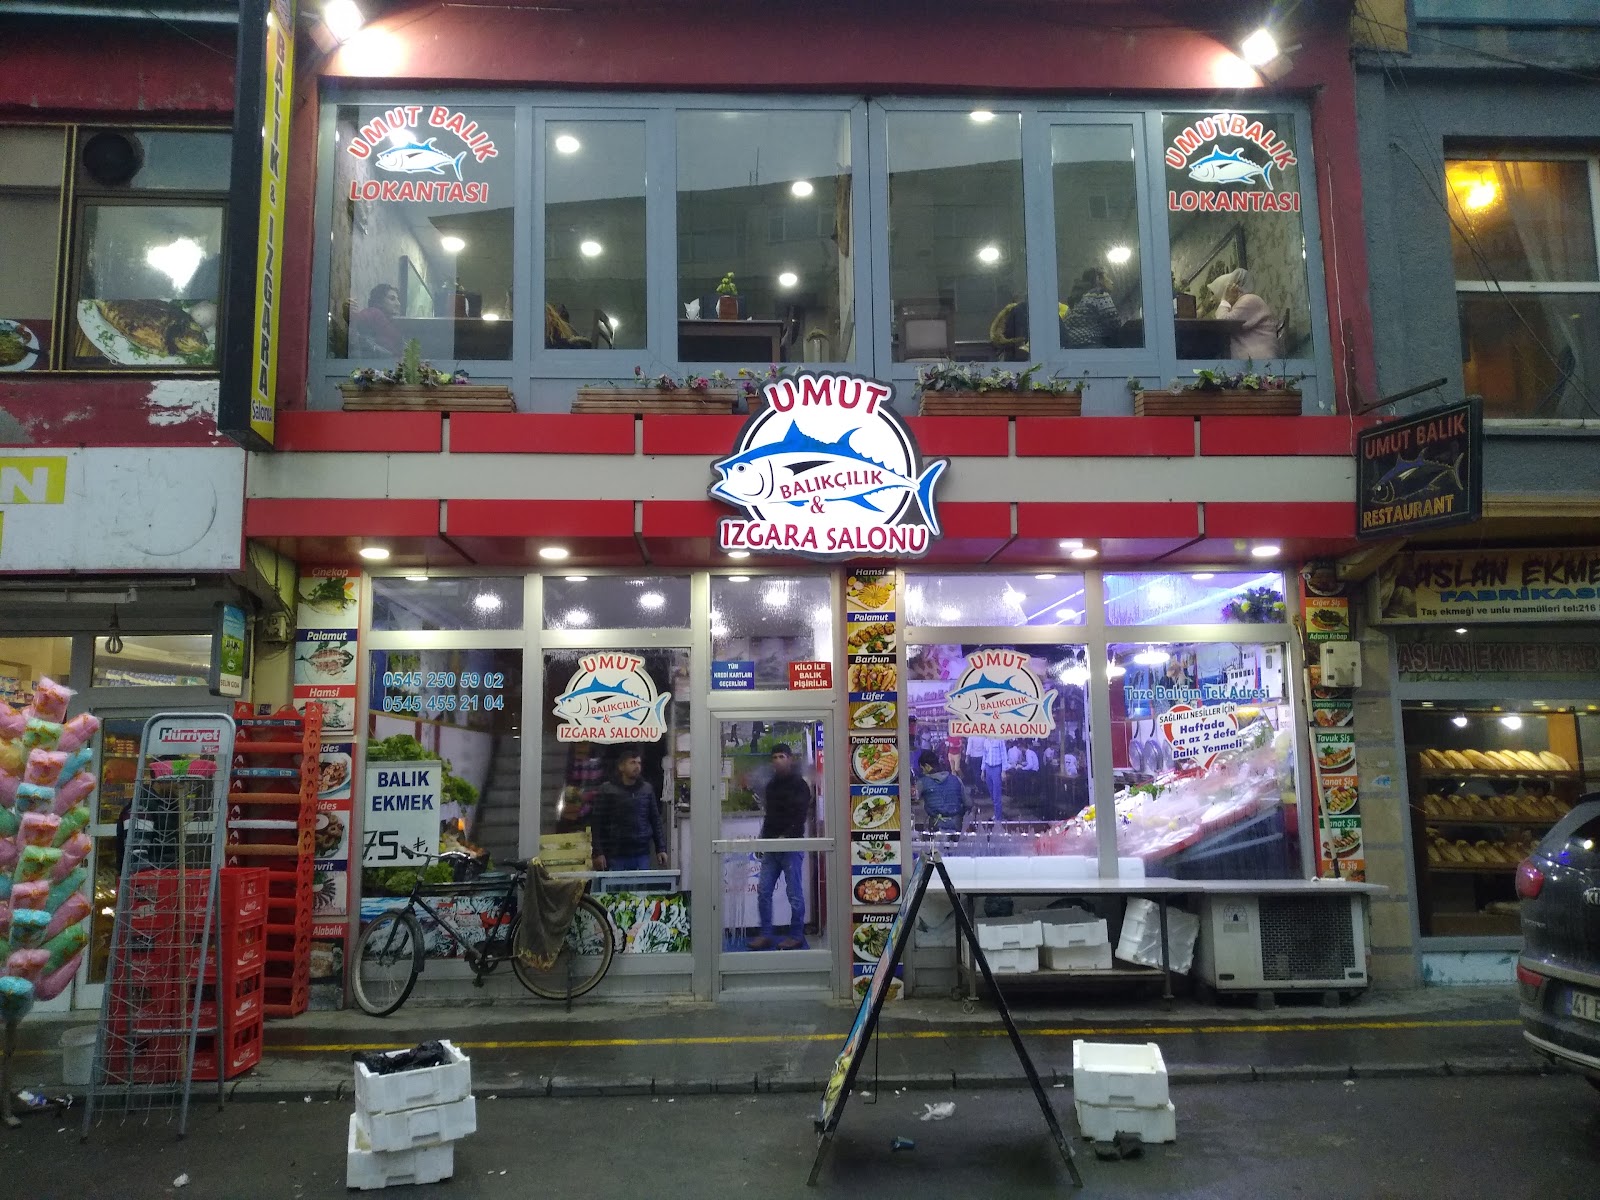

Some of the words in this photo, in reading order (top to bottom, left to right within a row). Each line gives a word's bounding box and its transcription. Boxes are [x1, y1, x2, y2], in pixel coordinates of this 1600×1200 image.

[270, 27, 286, 181] BALIK
[347, 106, 423, 159] UMUT
[428, 106, 498, 162] BALIK
[349, 181, 488, 203] LOKANTASI
[1169, 191, 1300, 212] LOKANTASI
[768, 378, 888, 414] UMUT
[1365, 429, 1411, 460] UMUT
[1416, 413, 1466, 446] BALIK
[780, 470, 884, 500] BALIKÇILIK
[810, 495, 826, 513] &
[1363, 494, 1455, 528] RESTAURANT
[722, 522, 818, 549] IZGARA
[827, 525, 927, 551] SALONU
[855, 568, 886, 576] Hamsi
[1415, 557, 1510, 587] ASLAN
[854, 614, 889, 622] Palamut
[1421, 607, 1437, 616] Taş
[307, 631, 347, 641] Palamut
[583, 656, 641, 672] UMUT
[855, 655, 889, 663] Barbun
[971, 653, 1026, 670] UMUT
[1399, 643, 1471, 671] ASLAN
[1475, 643, 1554, 671] EKMEK
[382, 671, 422, 688] 0545
[426, 671, 456, 688] 250
[460, 671, 480, 688] 59
[484, 672, 504, 688] 02
[309, 687, 340, 697] Hamsi
[861, 692, 885, 701] Lüfer
[1124, 686, 1153, 700] Taze
[1156, 685, 1201, 702] Balığın
[1204, 686, 1226, 698] Tek
[1229, 685, 1270, 698] Adresi
[382, 694, 422, 711] 0545
[426, 694, 456, 711] 455
[460, 694, 479, 711] 21
[484, 695, 504, 711] 04
[591, 700, 640, 715] BALIKÇILIK
[980, 696, 1028, 711] BALIKÇILIK
[603, 714, 611, 723] &
[992, 710, 1000, 720] &
[1159, 711, 1188, 723] SAĞLIKLI
[1190, 707, 1221, 718] NESİLLER
[1222, 705, 1235, 716] İÇİN
[159, 727, 220, 743] Hürriyet
[560, 727, 606, 738] IZGARA
[610, 727, 658, 738] SALONU
[952, 723, 996, 734] IZGARA
[1000, 723, 1047, 735] SALONU
[1180, 720, 1225, 734] Haftada
[1173, 738, 1185, 746] en
[1189, 736, 1200, 744] az
[1203, 733, 1210, 741] 2
[1213, 729, 1236, 740] defa
[1317, 734, 1339, 742] Tavuk
[1340, 734, 1350, 743] Şiş
[1173, 747, 1199, 759] Balık
[1202, 739, 1242, 754] Yenmeli
[377, 771, 430, 787] BALIK
[861, 786, 888, 795] Çipura
[372, 795, 434, 811] EKMEK
[861, 833, 889, 841] Levrek
[861, 866, 892, 874] Karides
[862, 914, 893, 922] Hamsi
